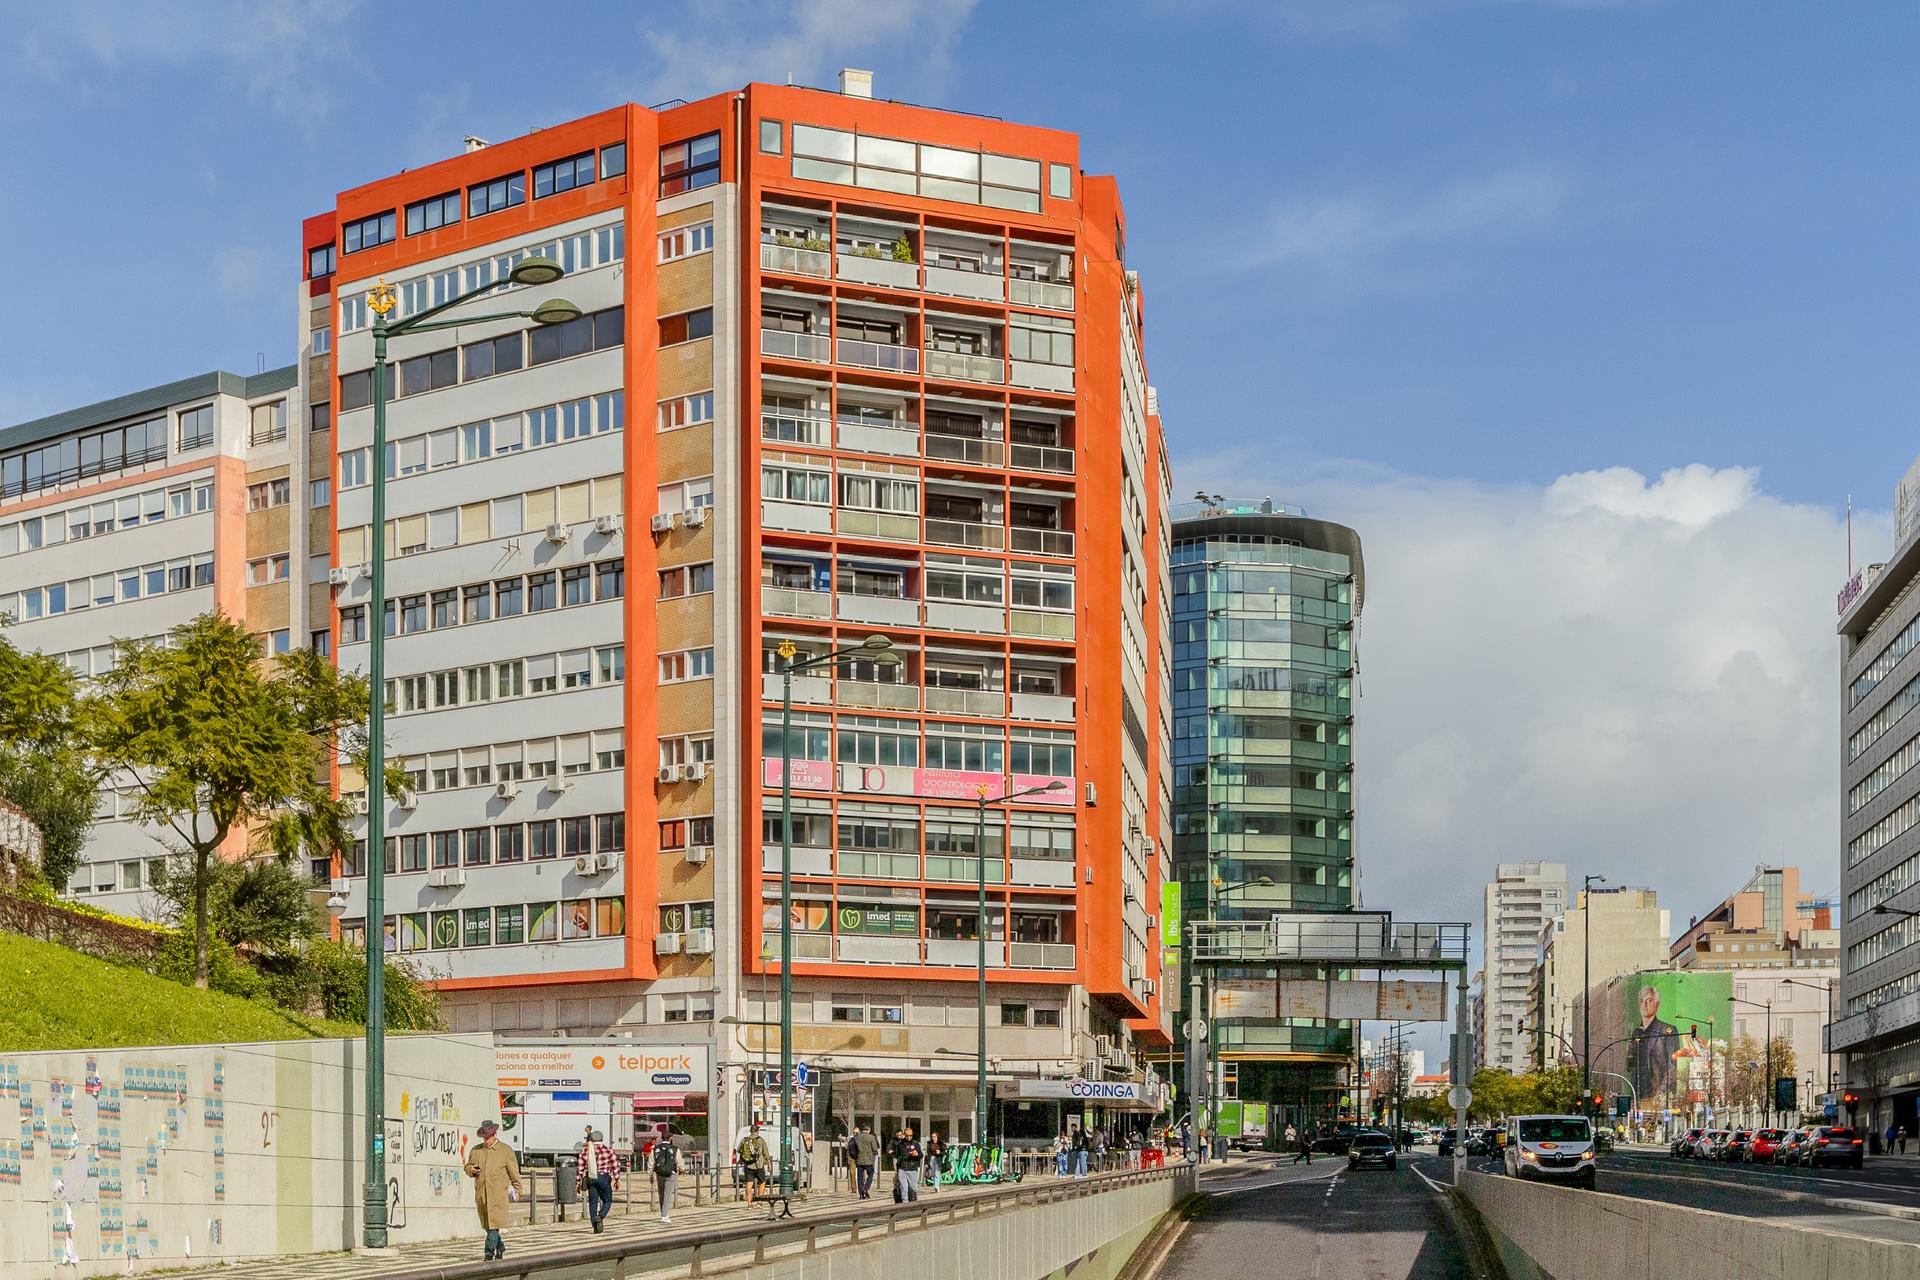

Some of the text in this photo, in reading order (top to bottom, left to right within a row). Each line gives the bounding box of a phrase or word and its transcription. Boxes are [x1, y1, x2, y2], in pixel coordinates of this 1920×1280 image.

[922, 779, 998, 791] ODONTOLOGO
[866, 911, 891, 921] imed
[465, 918, 490, 930] imed
[1167, 919, 1179, 937] ibis
[530, 1052, 572, 1061] qualquer
[528, 1063, 540, 1071] ao
[541, 1062, 575, 1071] melhor
[618, 1054, 690, 1073] telpark
[1071, 1083, 1135, 1098] CORINGA
[414, 1096, 439, 1121] FESTA
